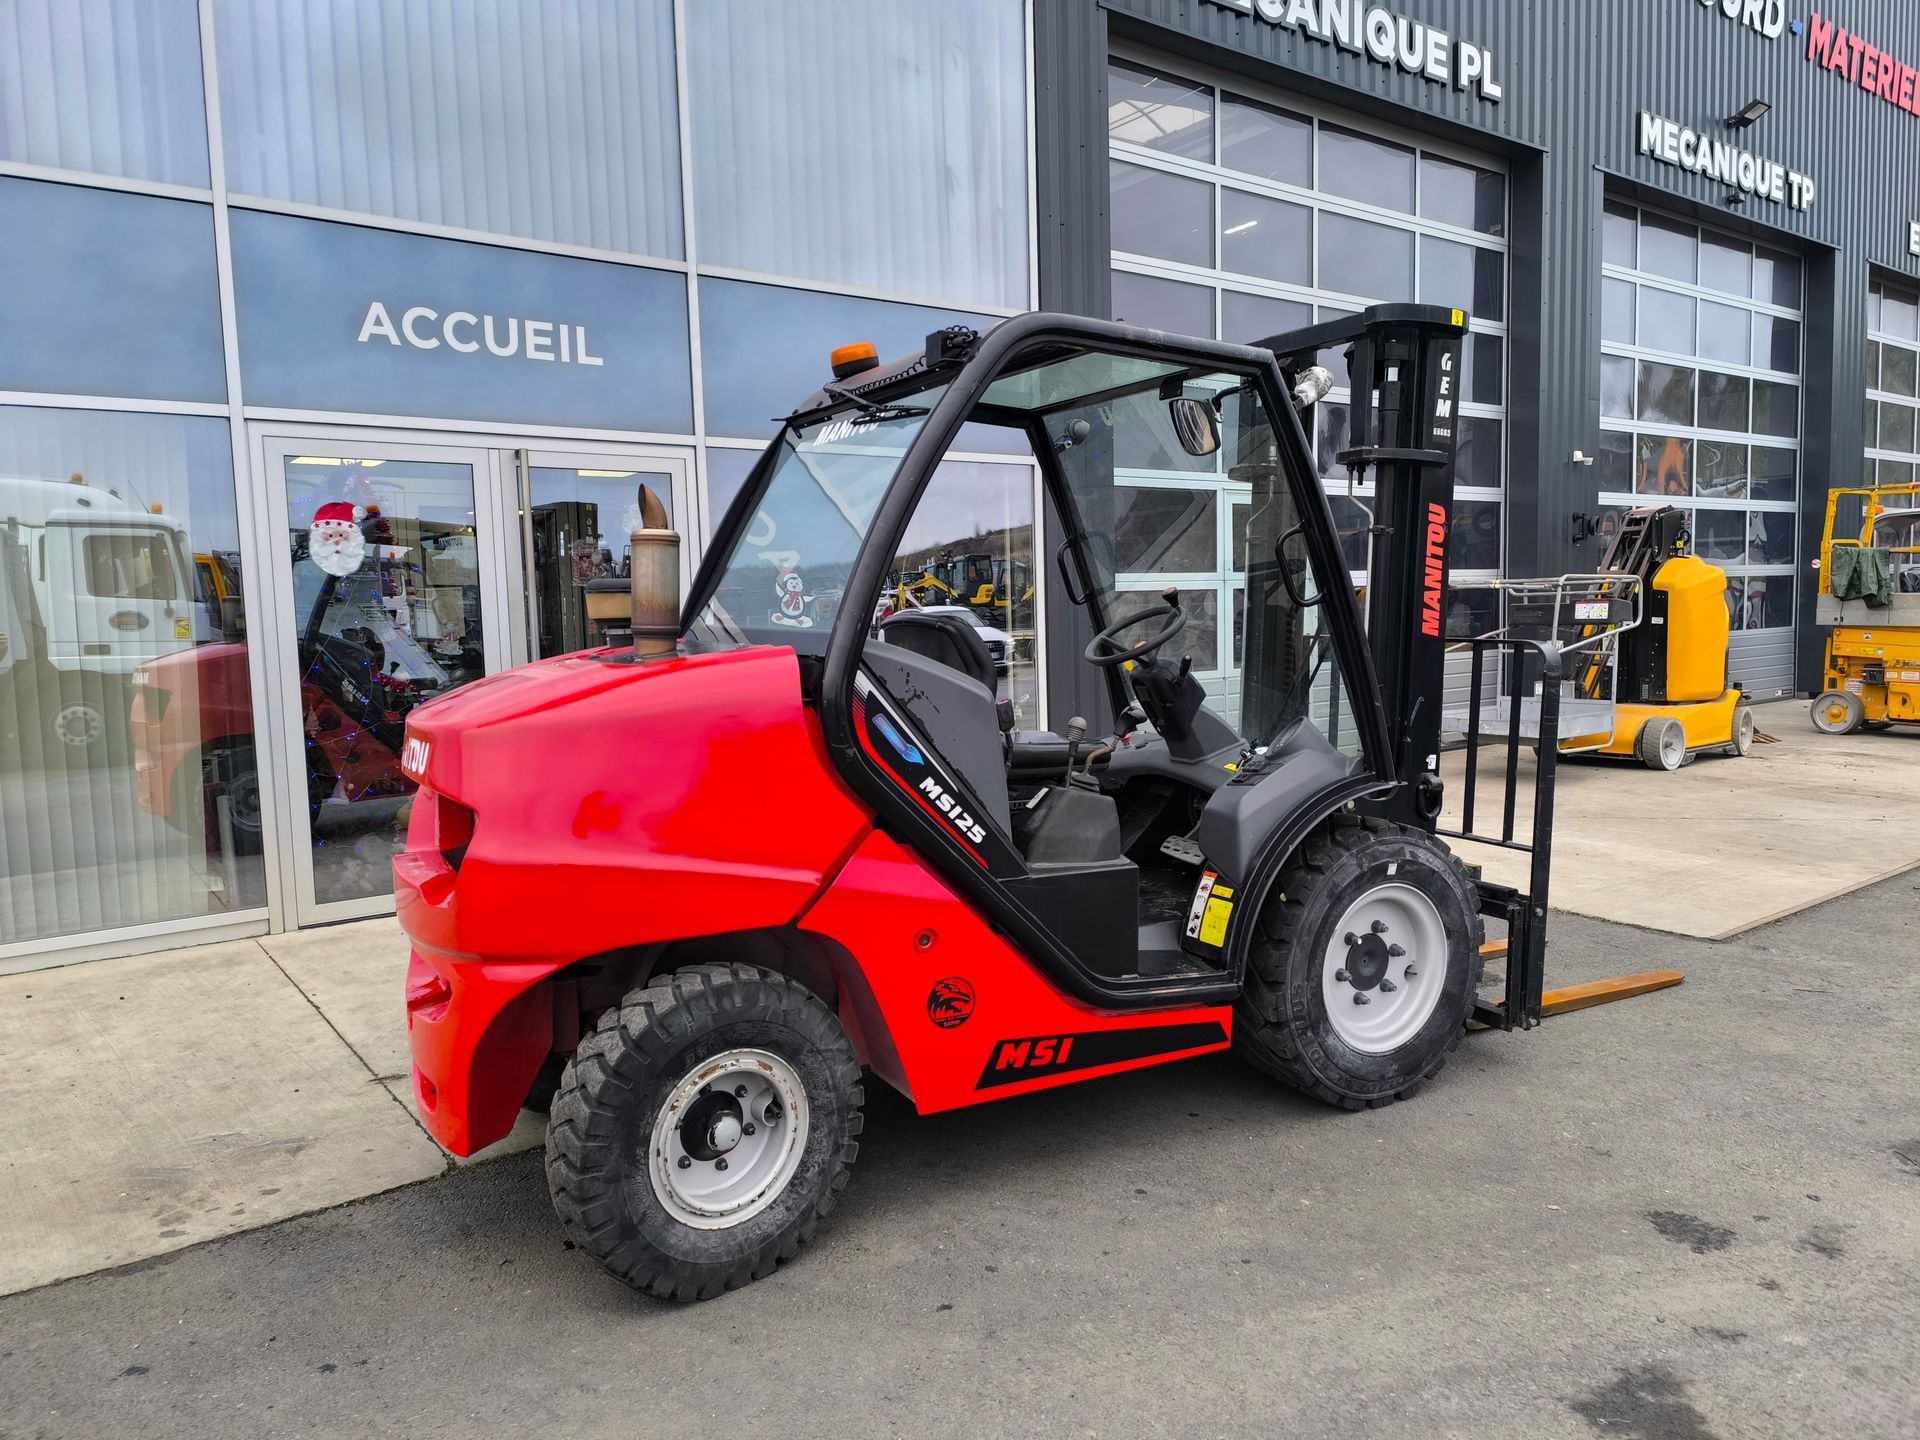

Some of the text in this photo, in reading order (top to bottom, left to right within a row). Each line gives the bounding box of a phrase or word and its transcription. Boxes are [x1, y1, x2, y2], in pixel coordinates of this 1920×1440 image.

[1459, 41, 1501, 98] PL
[1640, 111, 1814, 210] MECANIQUE TP
[357, 302, 603, 365] ACCUEIL
[1435, 352, 1452, 418] GEM
[1422, 502, 1446, 636] MANITOU
[995, 1038, 1074, 1070] MSI
